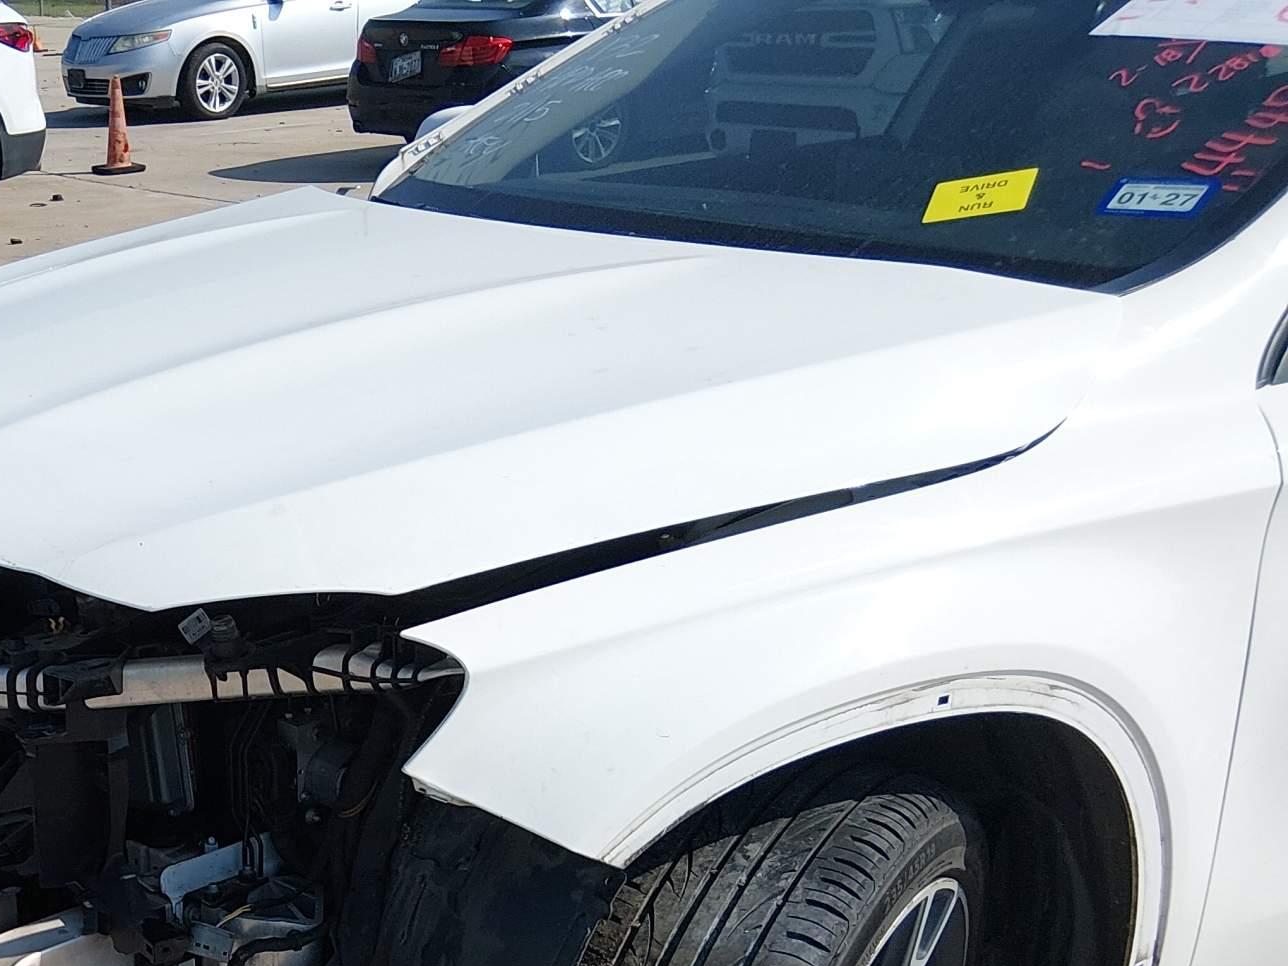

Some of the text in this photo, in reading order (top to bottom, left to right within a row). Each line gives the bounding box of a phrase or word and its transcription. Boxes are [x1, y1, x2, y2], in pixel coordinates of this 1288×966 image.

[959, 180, 1009, 194] DRIVE
[975, 192, 986, 200] &
[957, 201, 994, 214] RUN
